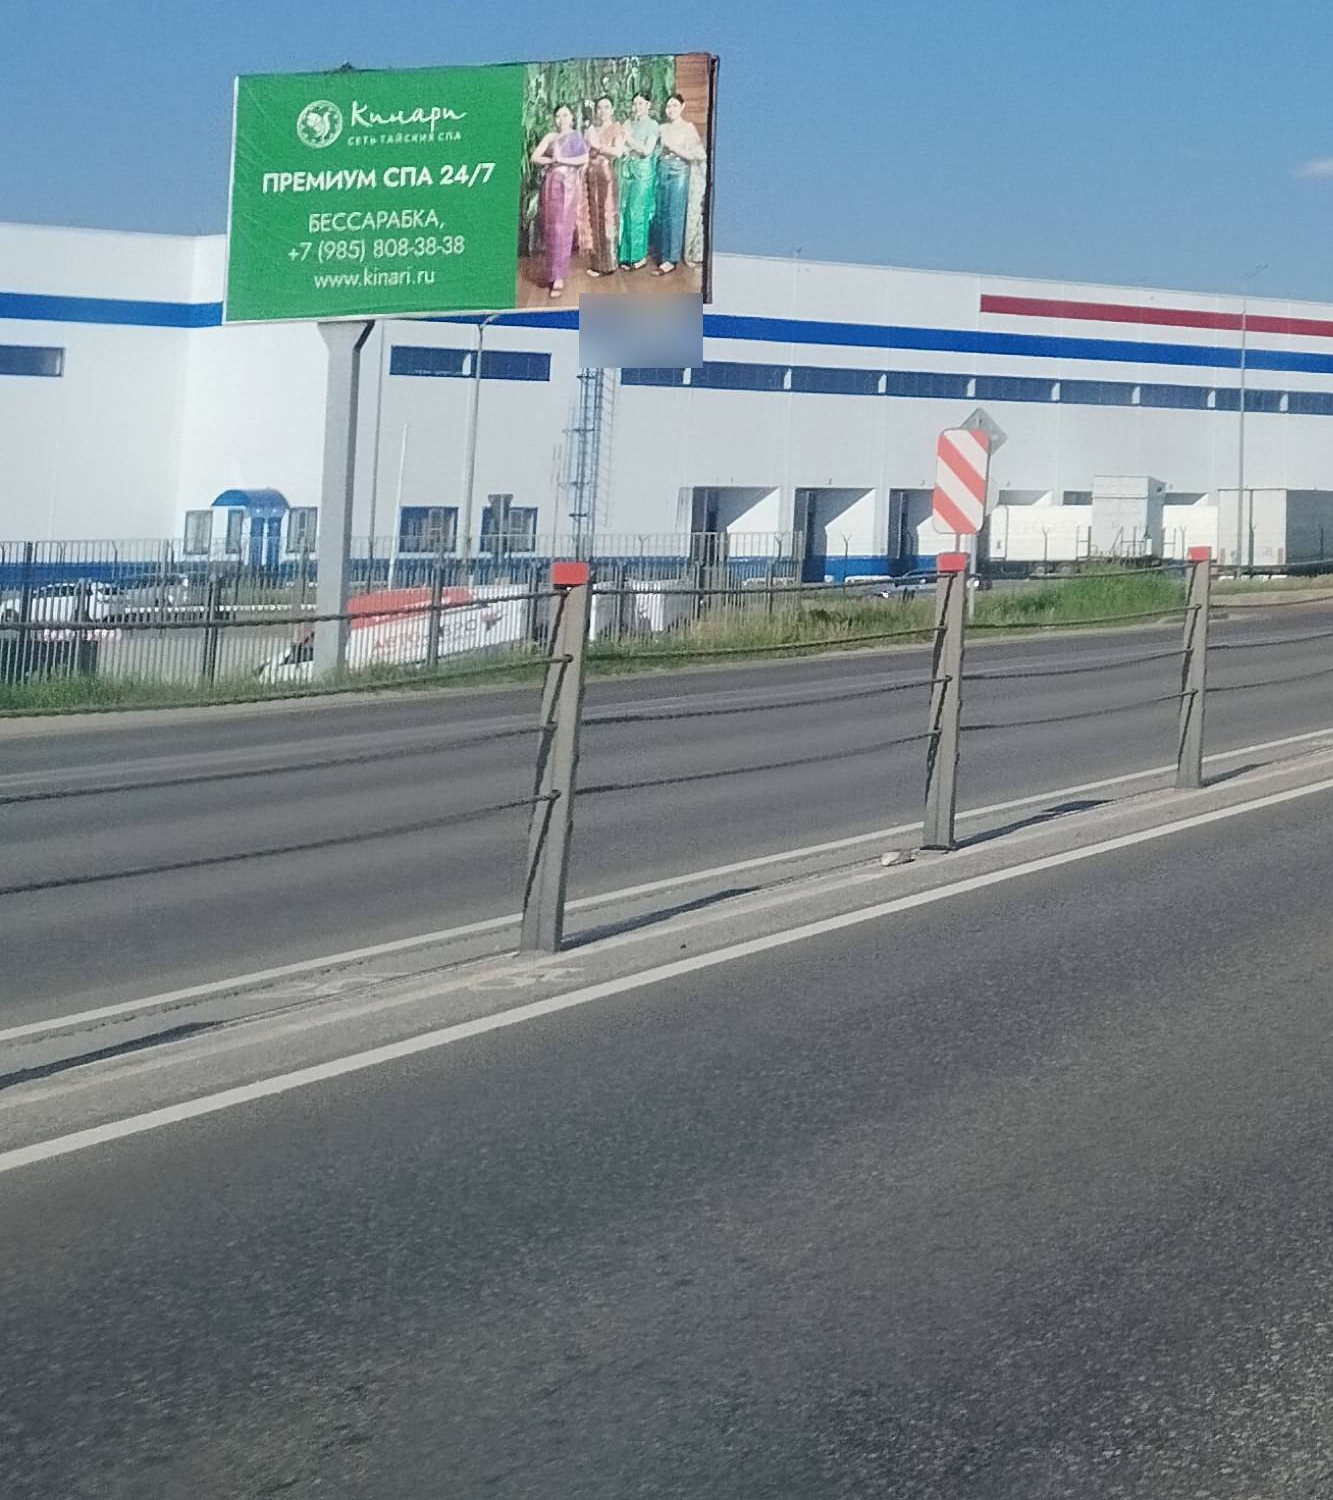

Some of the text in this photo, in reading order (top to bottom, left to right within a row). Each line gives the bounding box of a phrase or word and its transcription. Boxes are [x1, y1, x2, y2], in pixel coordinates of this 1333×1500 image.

[351, 100, 468, 132] Кинари
[347, 135, 377, 147] СЕТЬ
[437, 131, 462, 142] СПА
[262, 162, 497, 194] ПРЕМИУМ СПА 24/7
[308, 208, 446, 233] БЕССАРАБКА,
[287, 235, 466, 263] +7 (985) 808-38-38
[313, 266, 436, 289] www.kinari.ru
